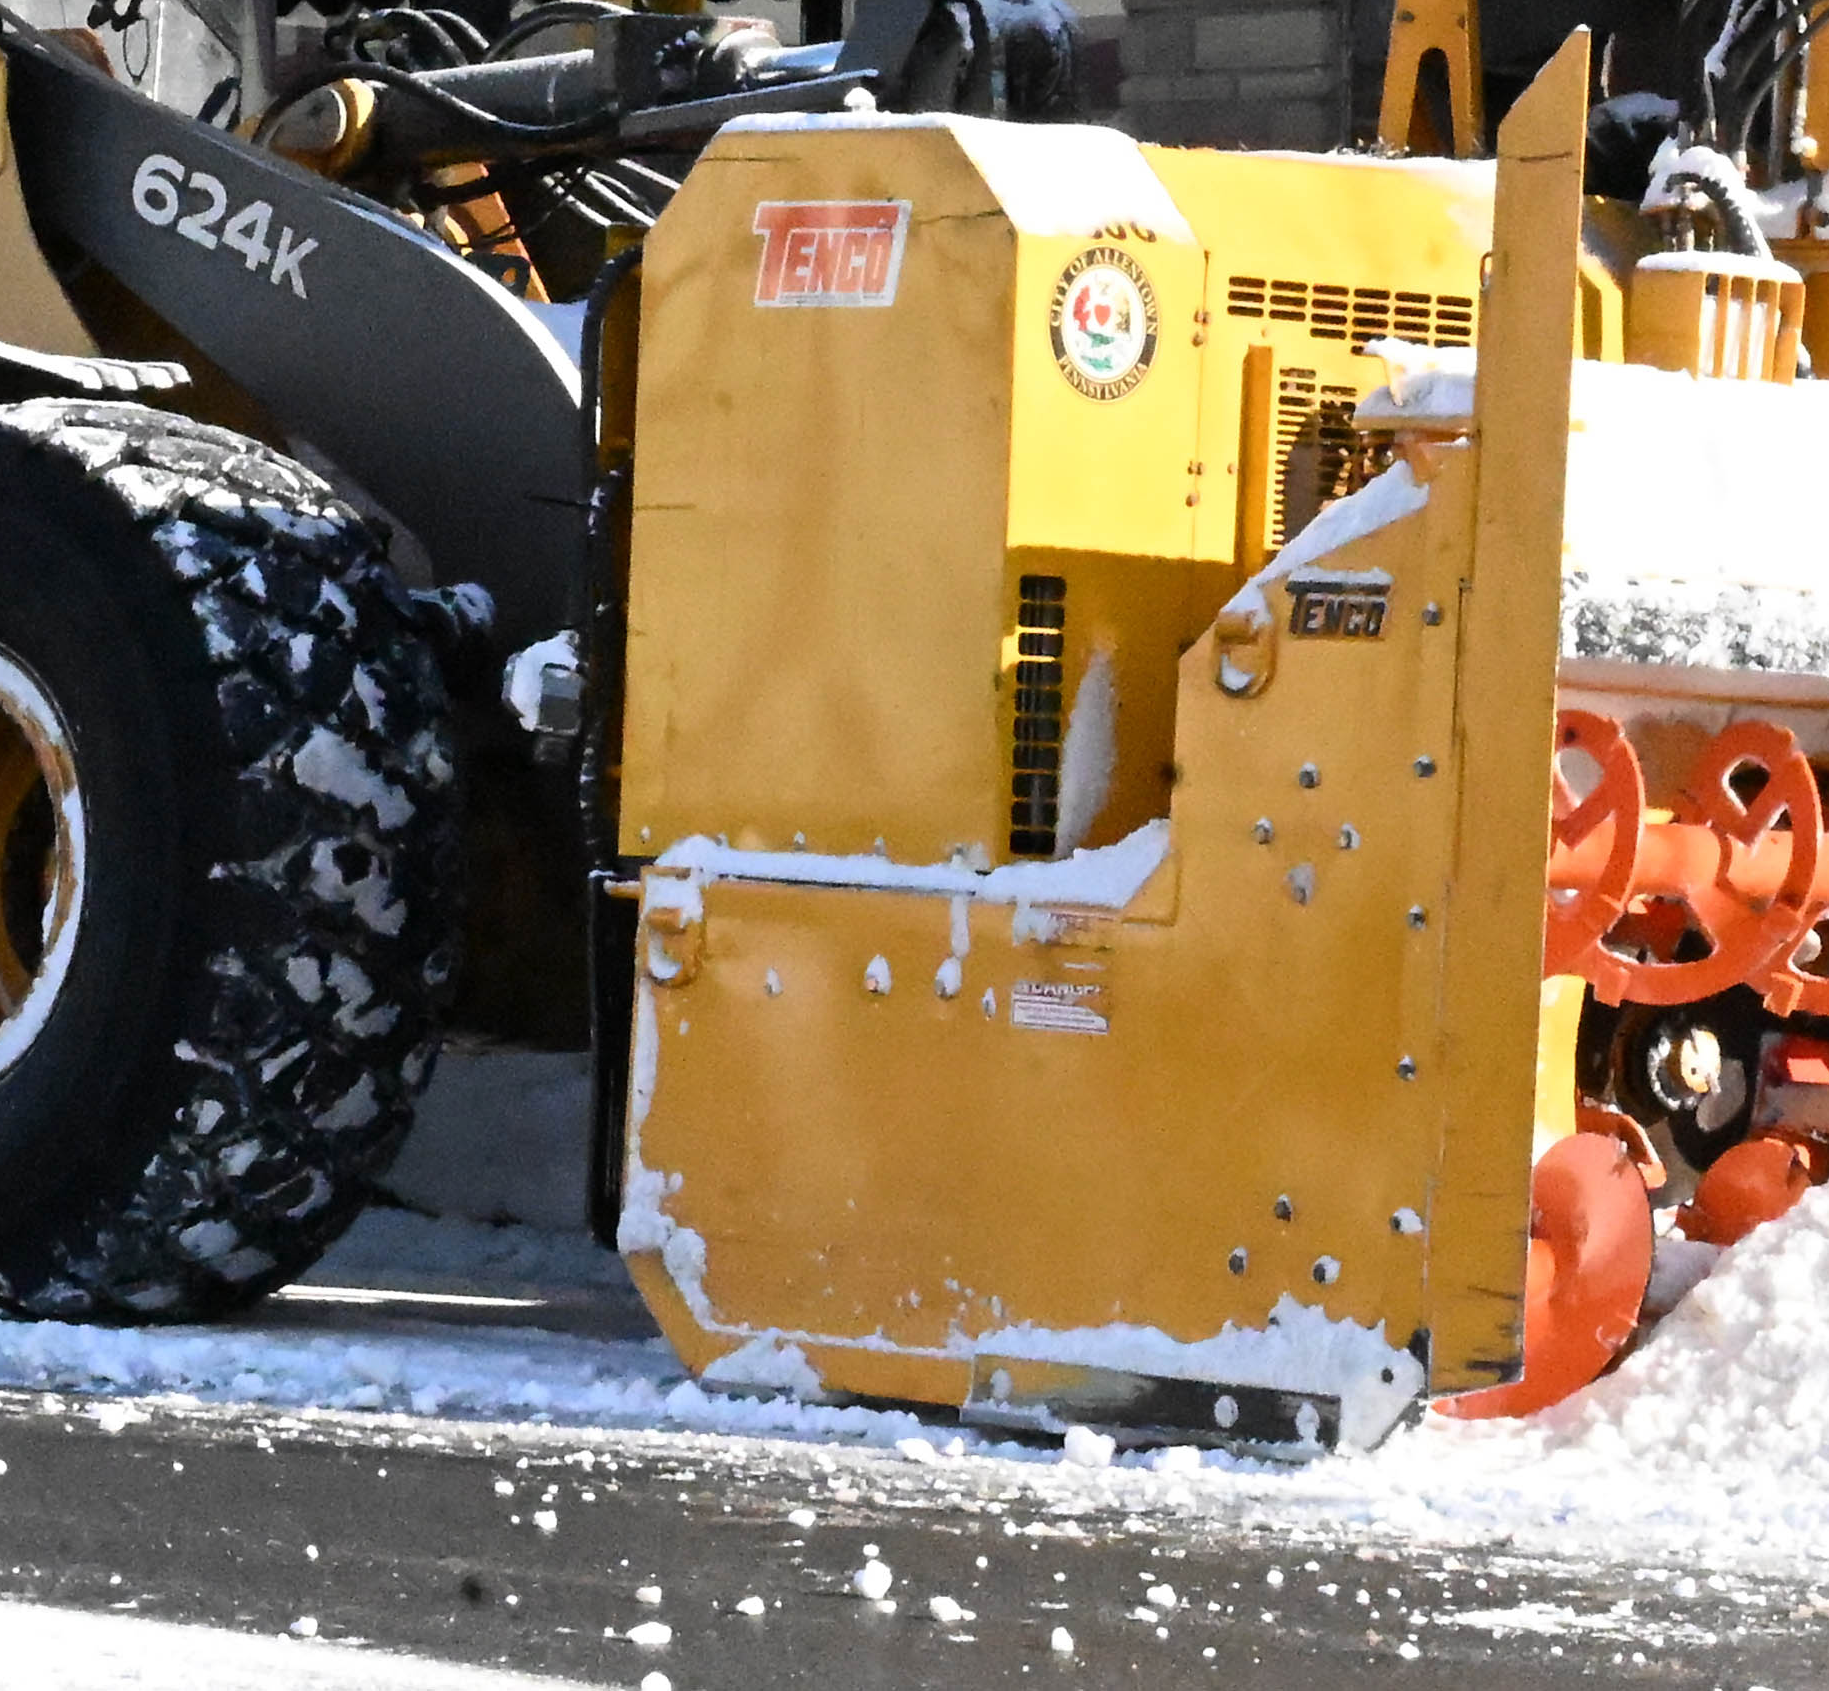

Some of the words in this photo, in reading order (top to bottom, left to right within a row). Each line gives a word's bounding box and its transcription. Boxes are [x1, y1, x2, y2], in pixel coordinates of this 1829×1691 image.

[132, 154, 319, 299] 624K
[756, 204, 900, 301] TENCO
[1051, 276, 1072, 327] CITY
[1070, 255, 1088, 276] OF
[1093, 248, 1158, 335] ALLENTOWN
[1058, 354, 1149, 400] PENNSYLVANIA
